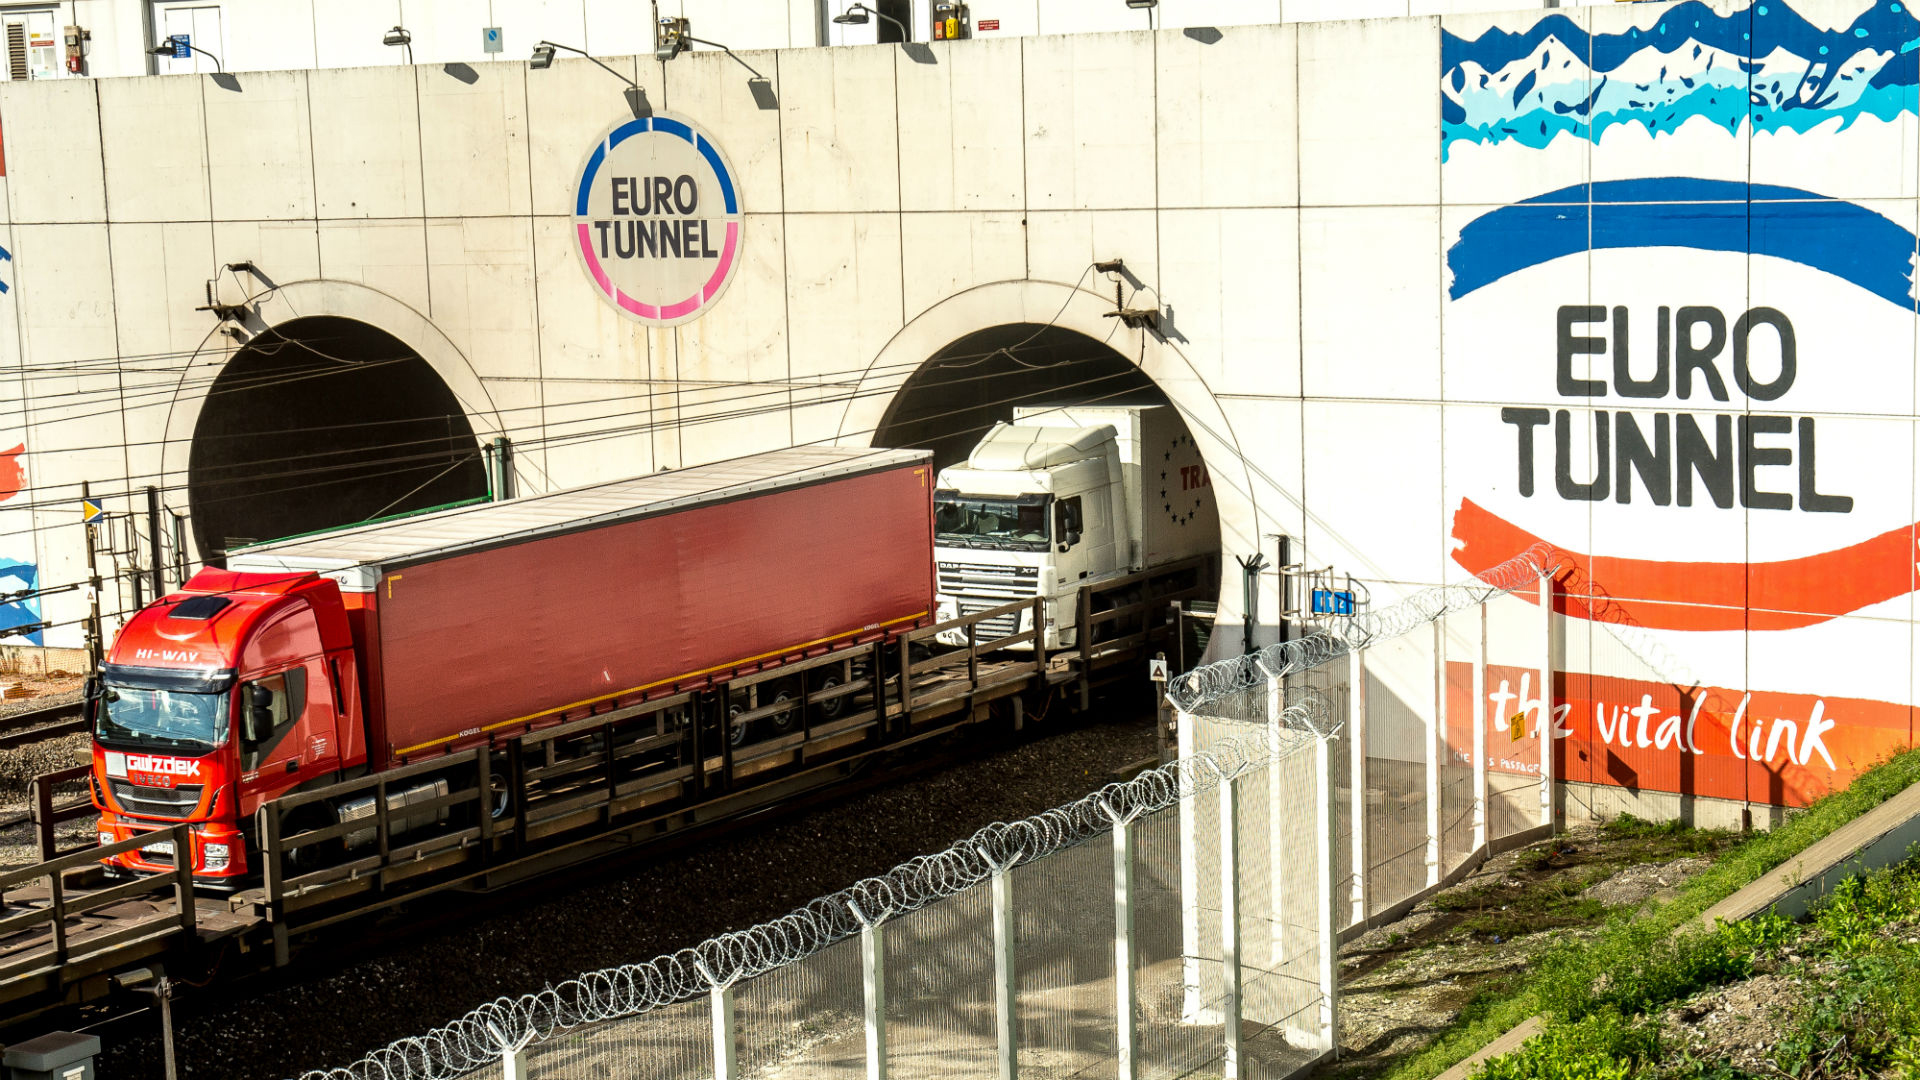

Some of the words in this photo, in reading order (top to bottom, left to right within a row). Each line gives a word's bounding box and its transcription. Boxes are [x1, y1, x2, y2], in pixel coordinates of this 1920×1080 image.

[611, 174, 698, 216] EURO
[594, 219, 718, 259] TUNNEL
[1556, 305, 1796, 402] EURO
[1501, 407, 1854, 513] TUNNEL
[136, 648, 199, 662] HI-WAY
[1596, 690, 1705, 755] vital
[1730, 691, 1838, 772] link
[133, 773, 171, 788] IVECO
